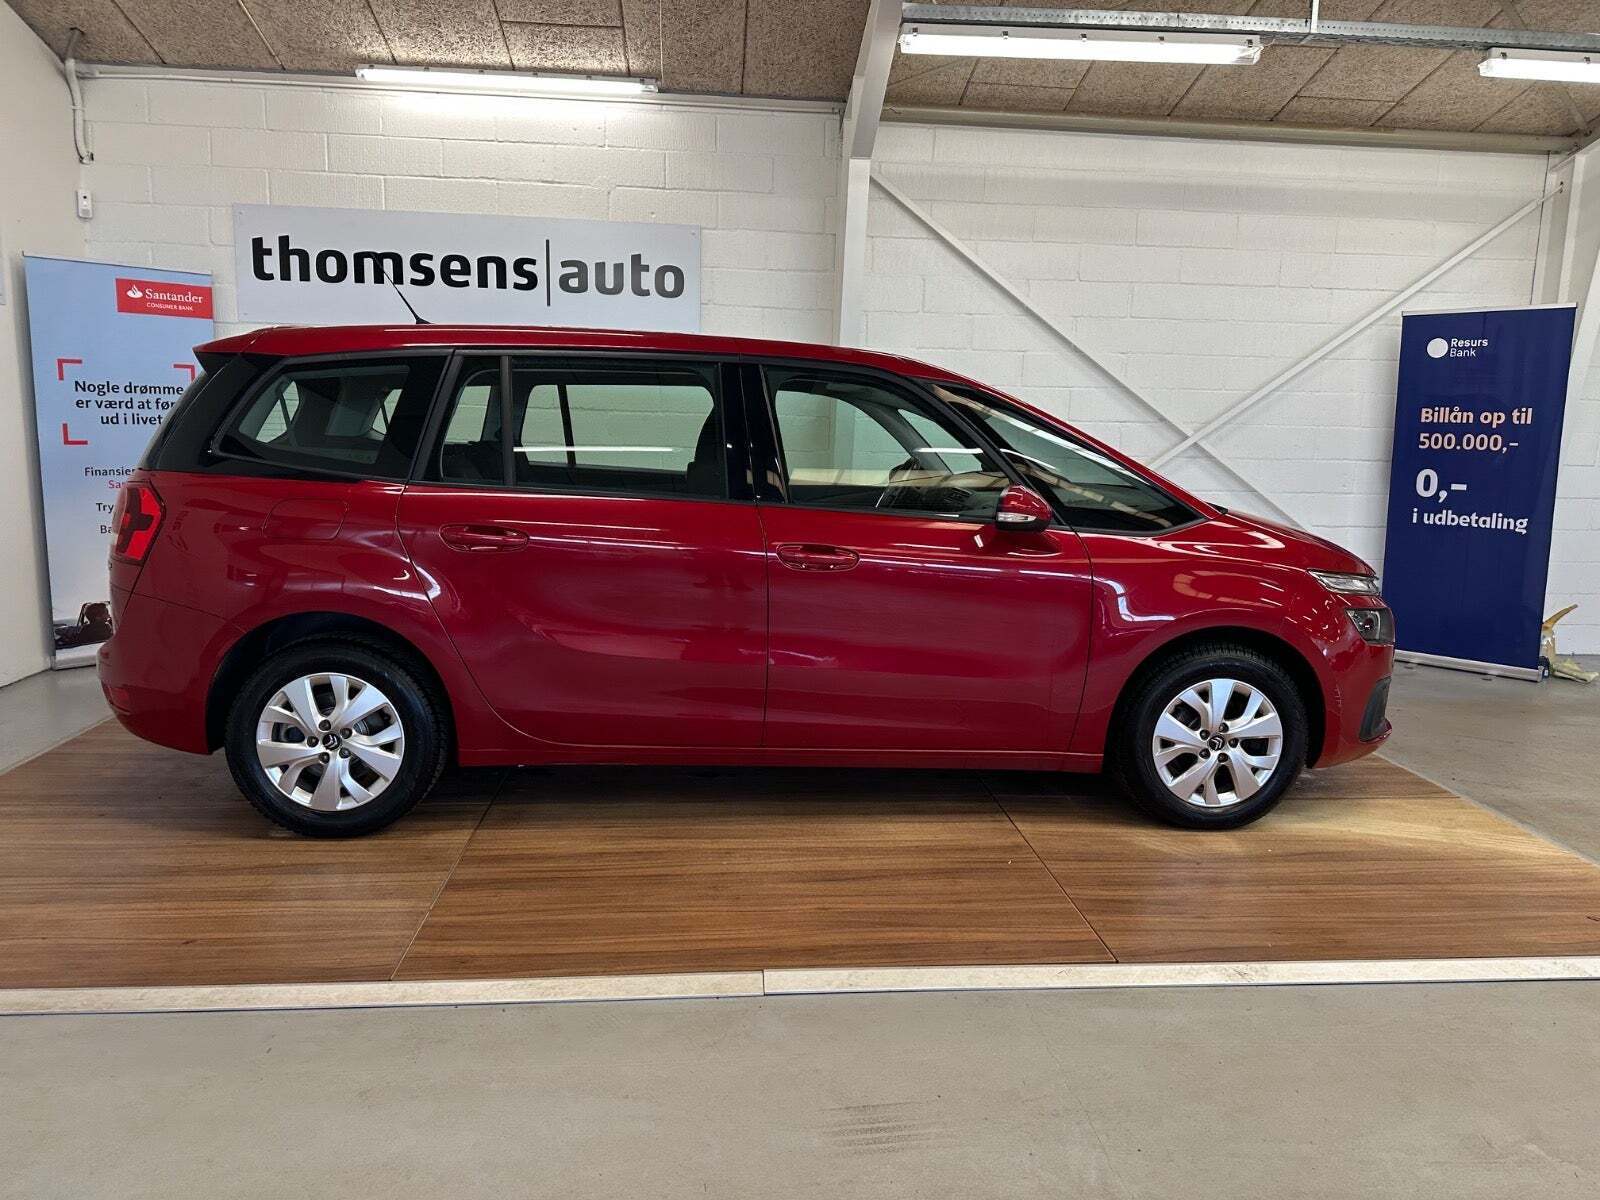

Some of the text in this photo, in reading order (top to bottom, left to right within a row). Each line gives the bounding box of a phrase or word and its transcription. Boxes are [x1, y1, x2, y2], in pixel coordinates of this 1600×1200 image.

[251, 235, 685, 298] thomsens auto
[145, 288, 203, 303] Santander
[146, 302, 178, 310] CONSUMER
[1450, 338, 1489, 347] Resurs
[1450, 347, 1476, 357] Bank
[74, 380, 184, 396] Nogle drømme
[75, 398, 91, 409] er
[95, 397, 133, 410] værd
[137, 399, 152, 410] at
[100, 413, 163, 425] ud i livet
[1420, 406, 1533, 428] Billån op til
[96, 502, 114, 514] Try
[1412, 508, 1529, 535] i udbetaling
